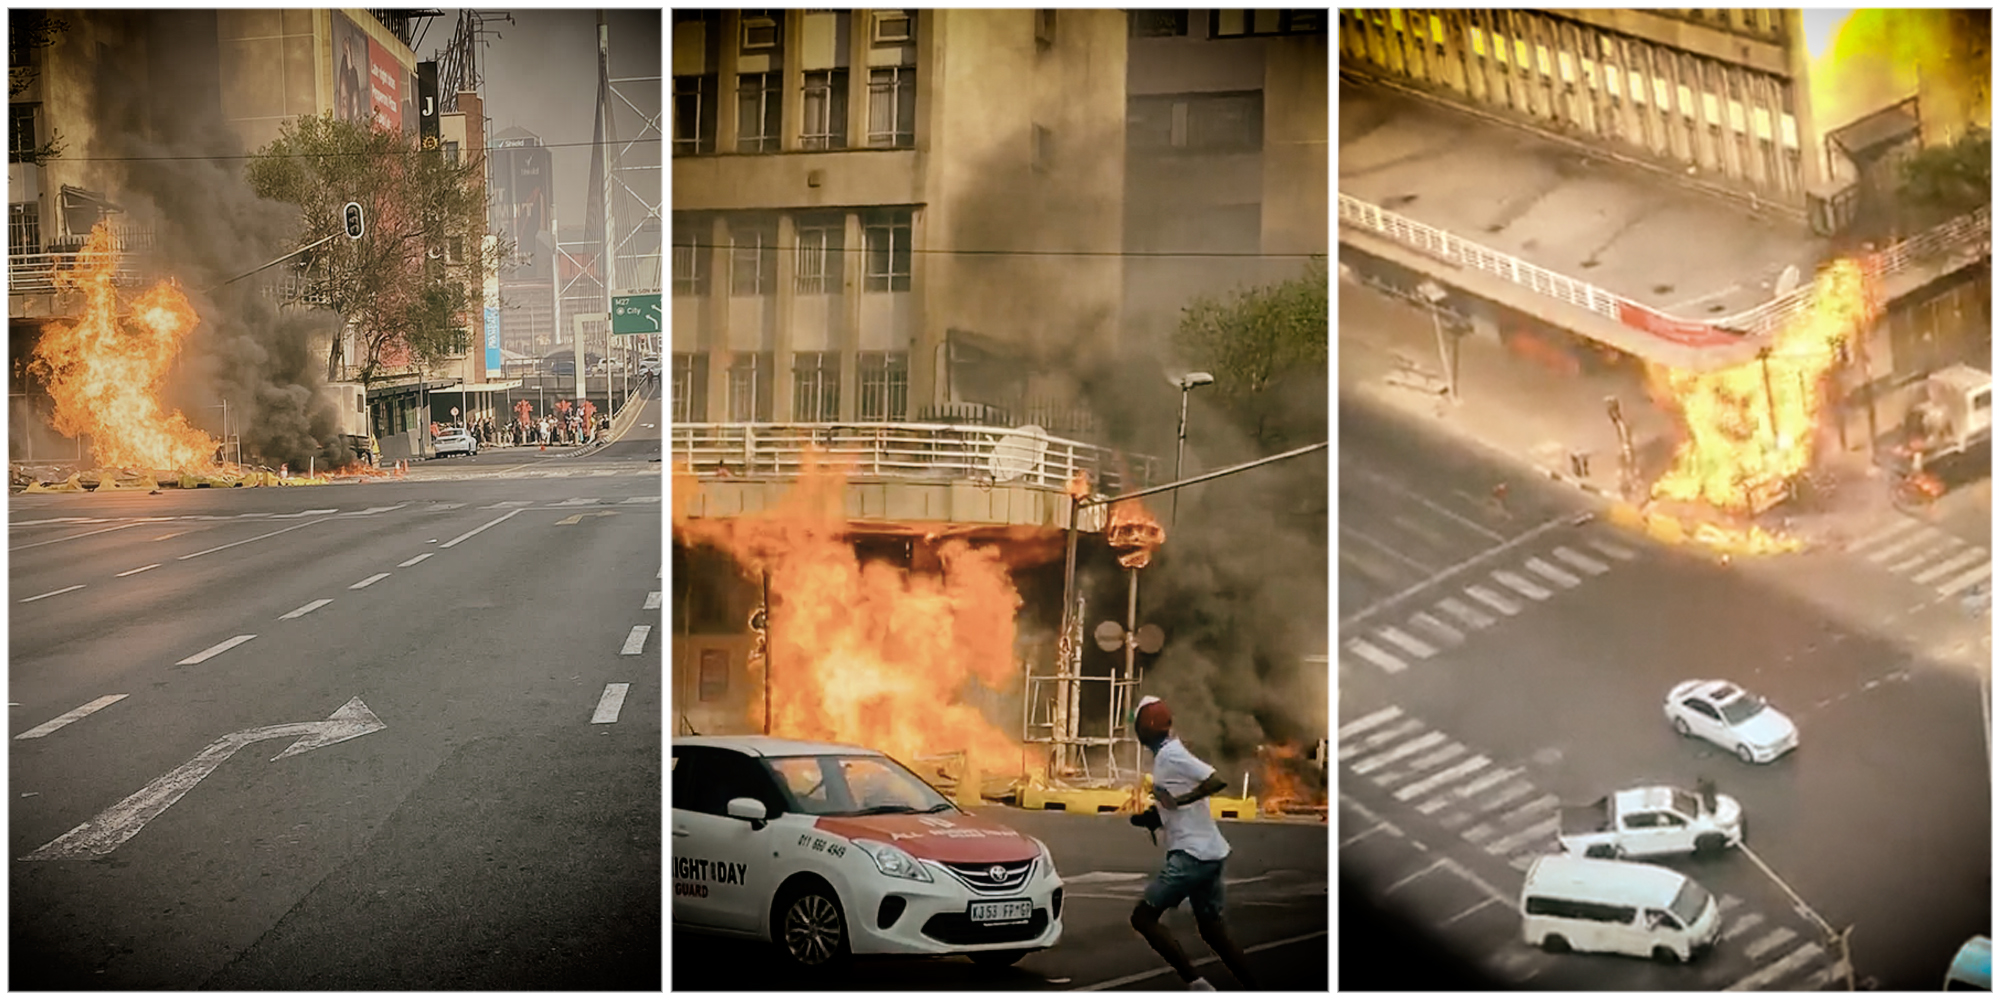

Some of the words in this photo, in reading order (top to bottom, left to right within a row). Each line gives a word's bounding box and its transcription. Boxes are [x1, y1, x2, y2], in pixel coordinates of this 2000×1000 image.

[422, 96, 434, 117] J
[505, 138, 524, 148] Shield
[615, 298, 630, 306] M27
[627, 307, 641, 316] City
[672, 856, 709, 881] IGHT
[717, 861, 748, 886] DAY
[675, 883, 709, 898] GUARD
